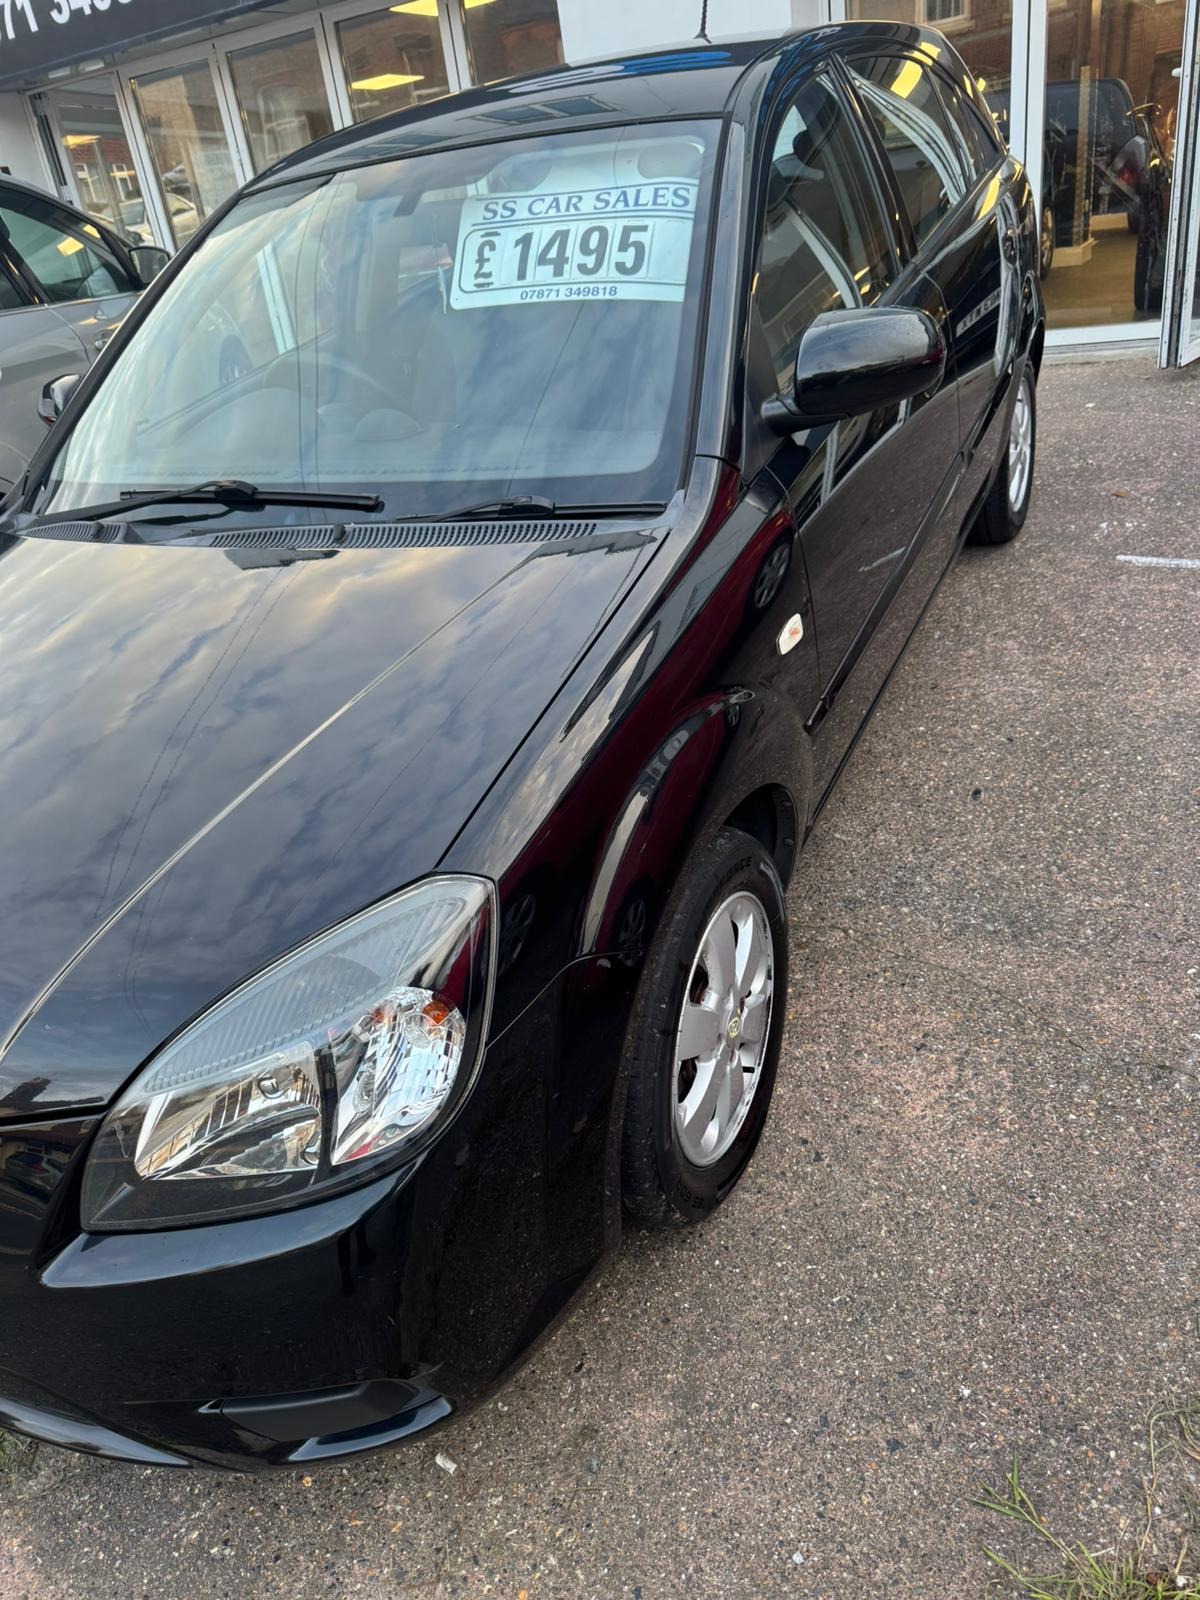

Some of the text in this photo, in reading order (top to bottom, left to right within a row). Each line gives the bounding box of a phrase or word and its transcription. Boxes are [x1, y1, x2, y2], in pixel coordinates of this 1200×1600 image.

[482, 186, 691, 221] SS CAR SALES
[520, 286, 618, 301] 07871 349818
